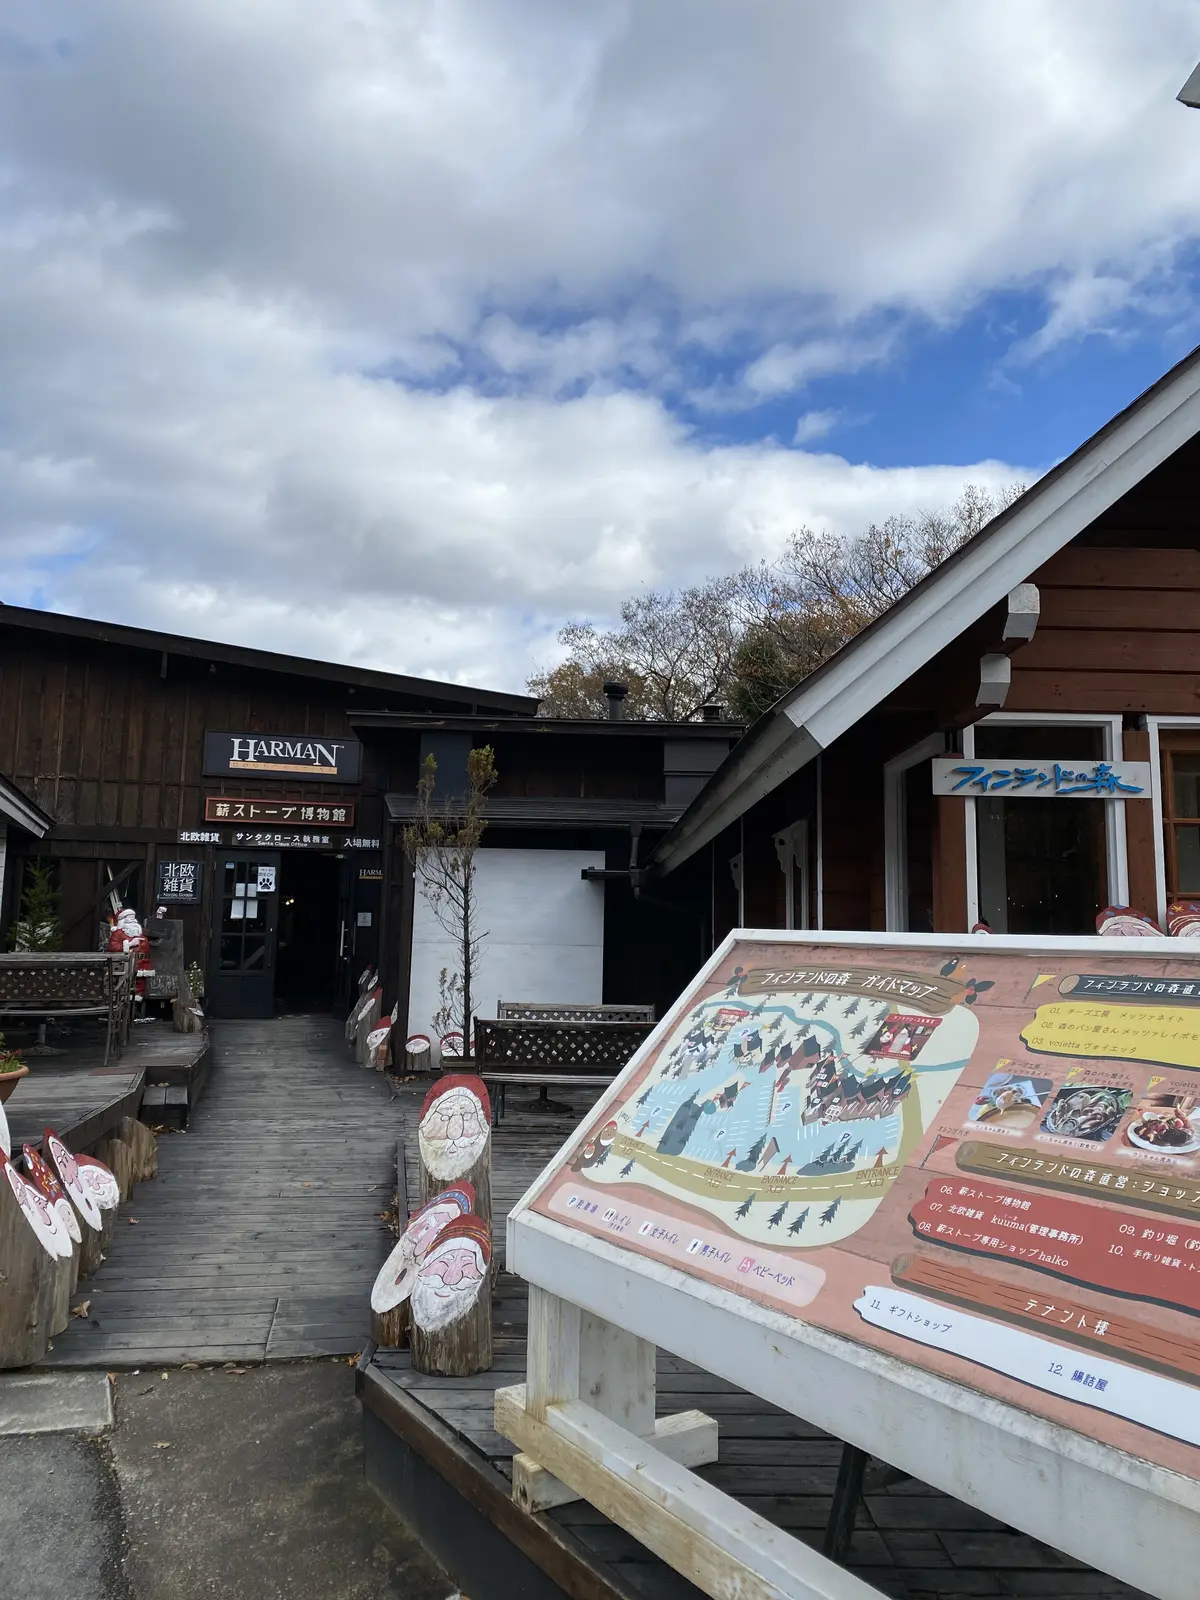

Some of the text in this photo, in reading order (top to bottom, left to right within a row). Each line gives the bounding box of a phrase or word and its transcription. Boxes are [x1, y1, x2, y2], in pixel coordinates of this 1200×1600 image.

[229, 738, 339, 766] HARMAN
[951, 763, 1145, 794] フィンランドの森
[215, 803, 346, 822] 薪ストーブ博物館
[180, 831, 220, 843] 北欧雑貨
[344, 838, 380, 848] 入場無料
[164, 863, 195, 877] 北欧
[163, 878, 194, 892] 雑貨
[761, 971, 938, 998] フィンランドの森 ガイドマップ
[1083, 979, 1200, 996] フィンランドの森直
[1067, 1008, 1111, 1019] チーズ工房
[704, 1168, 736, 1182] ENTRANCE
[761, 1175, 800, 1185] ENTRANCE
[856, 1166, 900, 1180] ENTRANCE
[958, 1186, 1032, 1211] 薪ストーブ博物館
[948, 1205, 984, 1221] 北欧雑貨
[1119, 1224, 1136, 1237] 09.
[700, 1244, 731, 1263] 男子トイレ
[1108, 1244, 1200, 1273] 10. 手作り雑貨・ト
[869, 1299, 953, 1333] 11. ギフトショップ
[1023, 1299, 1110, 1336] テナント様
[1047, 1361, 1109, 1392] 12. 腸詰屋
